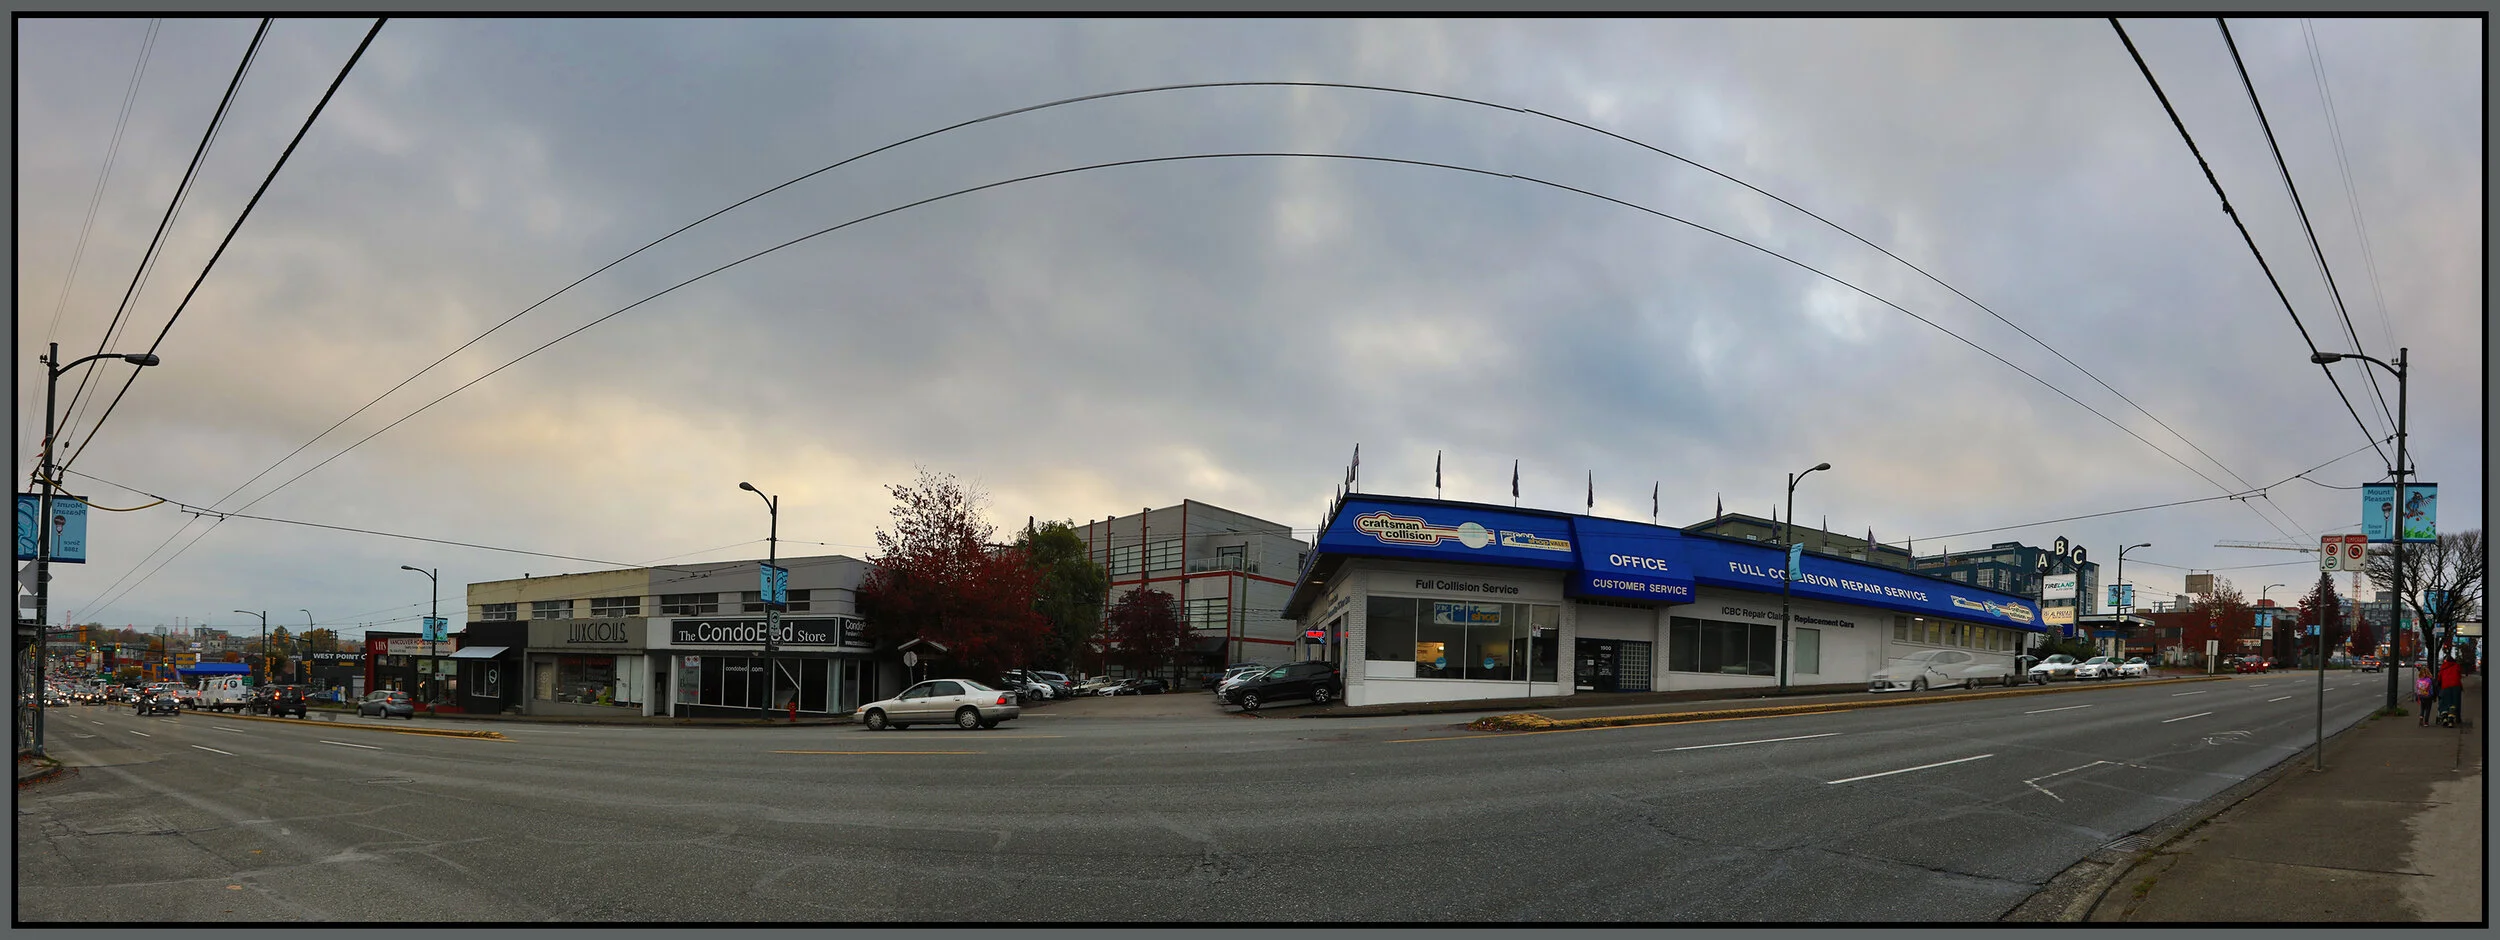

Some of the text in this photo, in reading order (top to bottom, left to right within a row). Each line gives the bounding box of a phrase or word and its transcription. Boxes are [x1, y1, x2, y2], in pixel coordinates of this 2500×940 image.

[1362, 519, 1420, 531] craftsman
[1385, 530, 1433, 541] collision
[2055, 540, 2065, 555] B
[1609, 554, 1668, 571] OFFICE
[2037, 553, 2048, 568] A
[2073, 550, 2083, 565] C
[1415, 579, 1519, 595] Full Collision Service
[1593, 578, 1687, 596] CUSTOMER SERVICE
[1729, 561, 1765, 577] FULL
[1768, 568, 1839, 588] COISION
[1841, 579, 1882, 595] REPAIR
[1884, 586, 1929, 602] SERVICE
[2045, 581, 2075, 590] TIRELAND
[1471, 611, 1500, 623] shop
[1721, 606, 1741, 616] ICBC
[1742, 608, 1766, 620] Repair
[1794, 614, 1839, 627] Replacement
[1839, 619, 1855, 628] Cars
[569, 622, 626, 641] LUXCIOUS
[679, 630, 696, 641] The
[797, 629, 826, 642] Store
